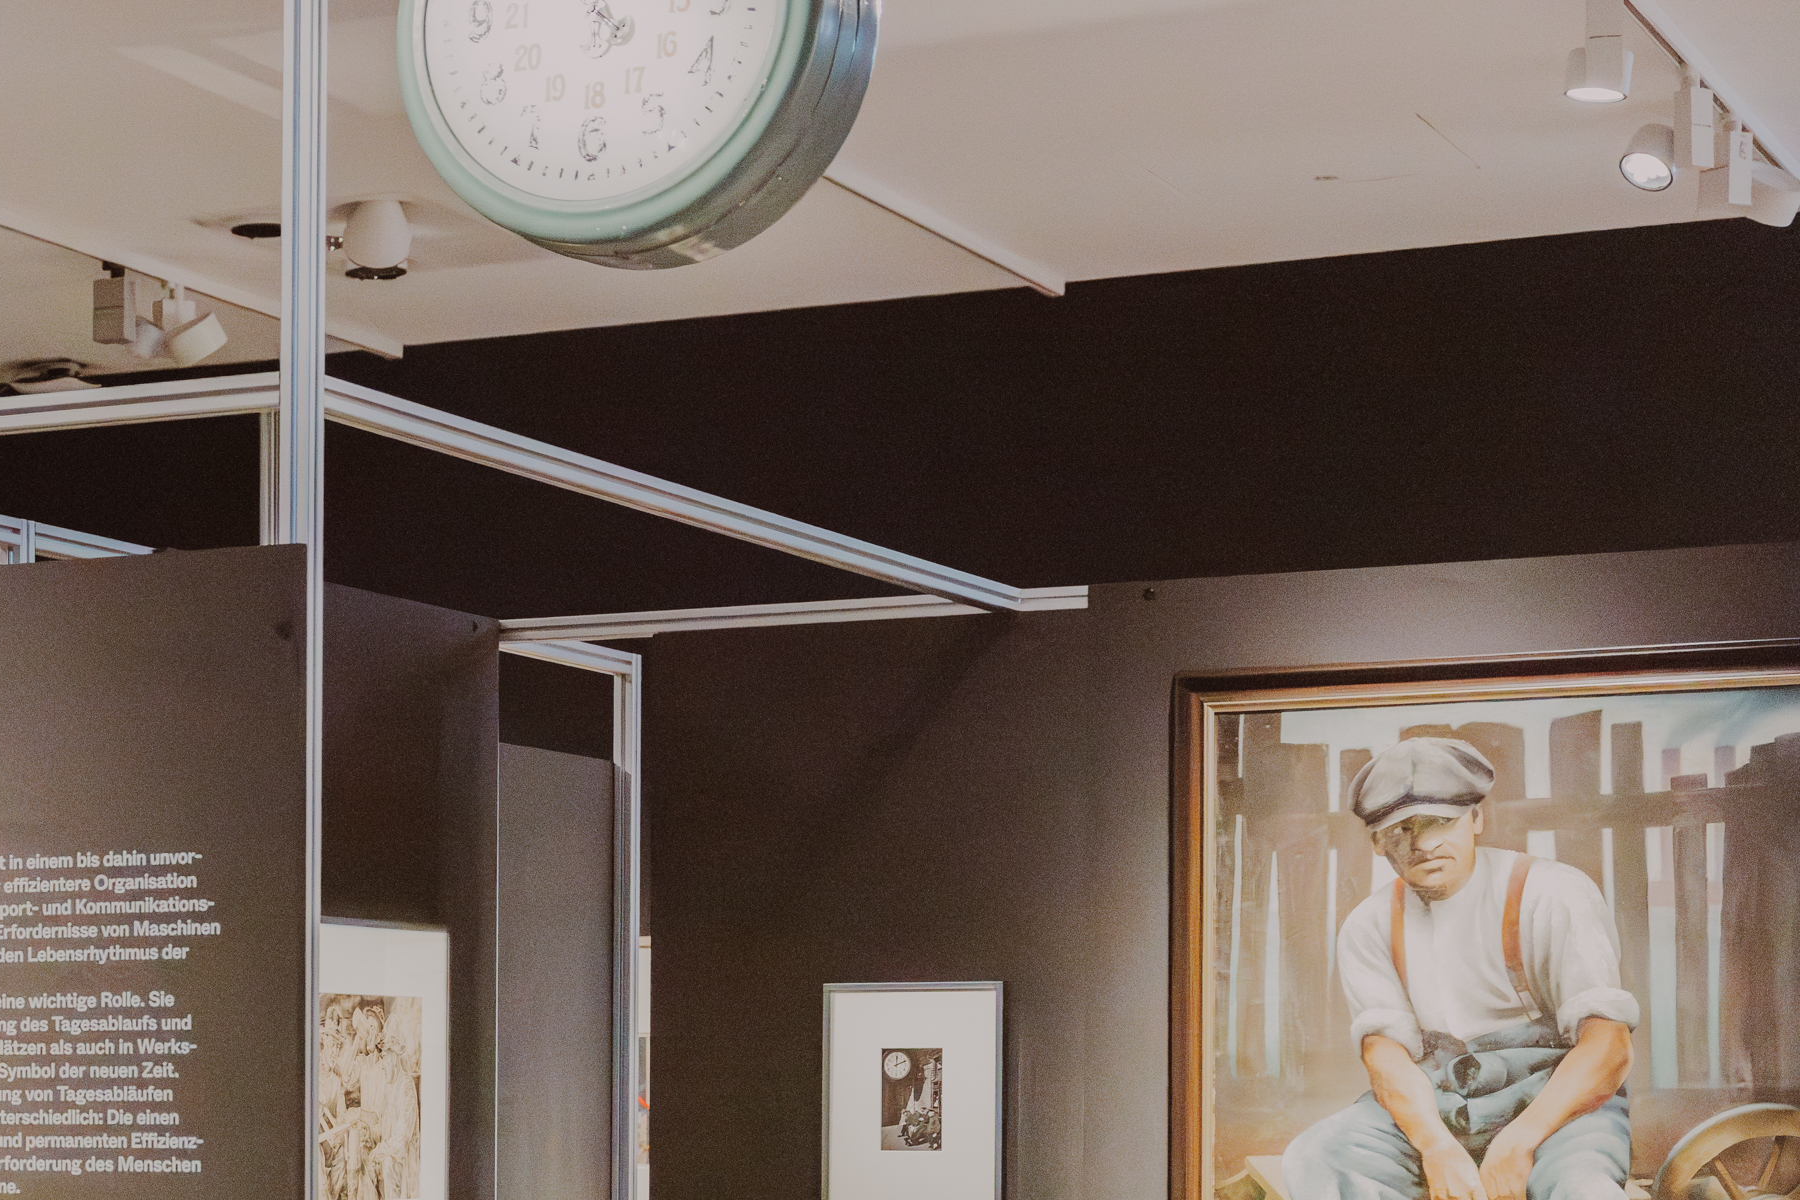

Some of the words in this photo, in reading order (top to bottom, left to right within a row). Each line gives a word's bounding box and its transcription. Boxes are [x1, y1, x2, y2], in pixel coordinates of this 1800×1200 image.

[505, 1, 529, 30] 21
[513, 43, 542, 72] 20
[656, 31, 677, 59] 16
[688, 35, 715, 87] 4
[544, 74, 566, 102] 19
[623, 66, 646, 95] 17
[584, 81, 606, 110] 18
[577, 115, 607, 162] 6
[9, 855, 23, 869] in
[26, 853, 73, 869] einem
[77, 851, 100, 867] bis
[103, 850, 146, 866] dahin
[150, 852, 203, 865] unvor-
[4, 877, 90, 893] effizientere
[94, 873, 197, 894] Organisation
[43, 899, 71, 916] und
[76, 896, 215, 914] Kommunikations-
[101, 924, 129, 937] von
[134, 920, 221, 936] Maschinen
[28, 945, 159, 964] Lebensrhythmus
[161, 944, 189, 960] der
[28, 992, 97, 1012] wichtige
[101, 991, 145, 1008] Rolle.
[149, 991, 175, 1007] Sie
